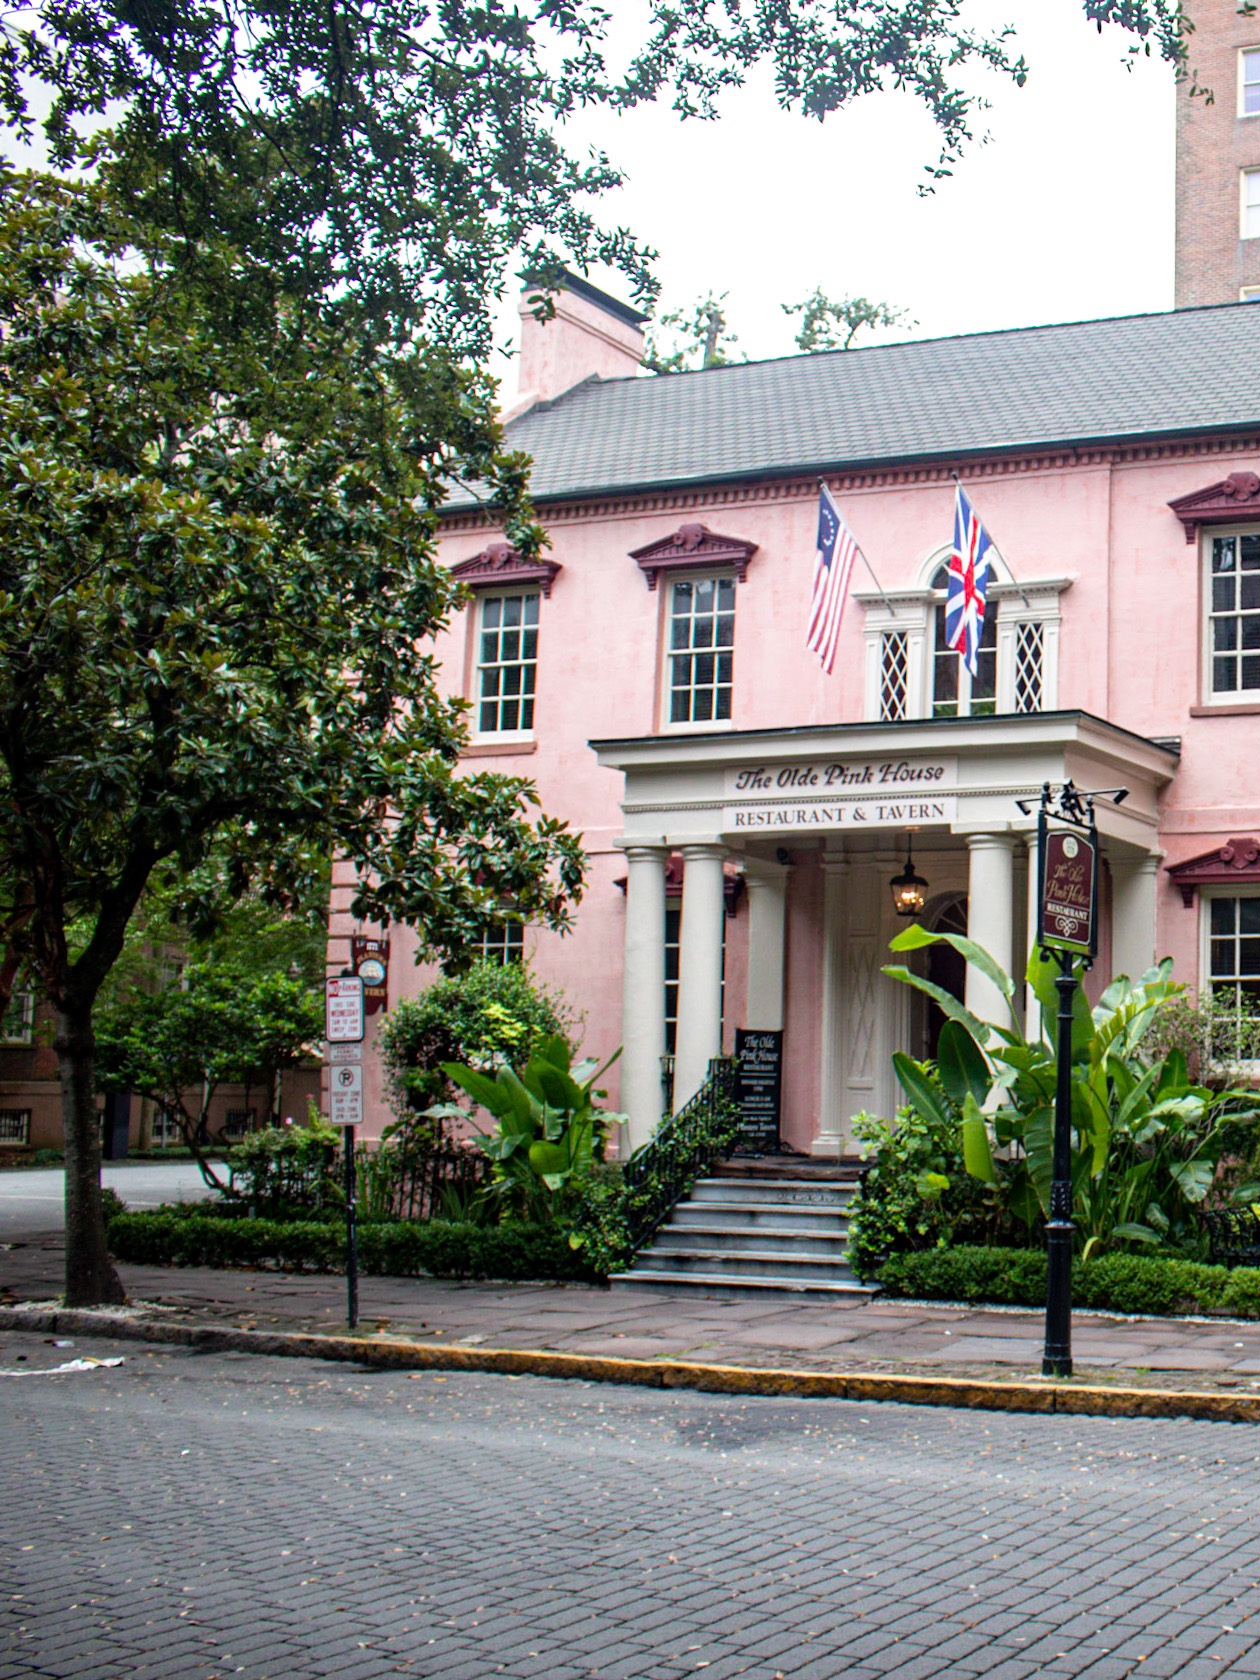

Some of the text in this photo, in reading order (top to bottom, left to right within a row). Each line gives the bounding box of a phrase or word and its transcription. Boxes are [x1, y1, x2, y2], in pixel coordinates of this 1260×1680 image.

[736, 761, 944, 790] The Olde Pink House
[736, 803, 945, 826] RESTAURANT & TAVERN
[1047, 880, 1067, 899] Pink
[1047, 902, 1088, 920] RESTAURANT
